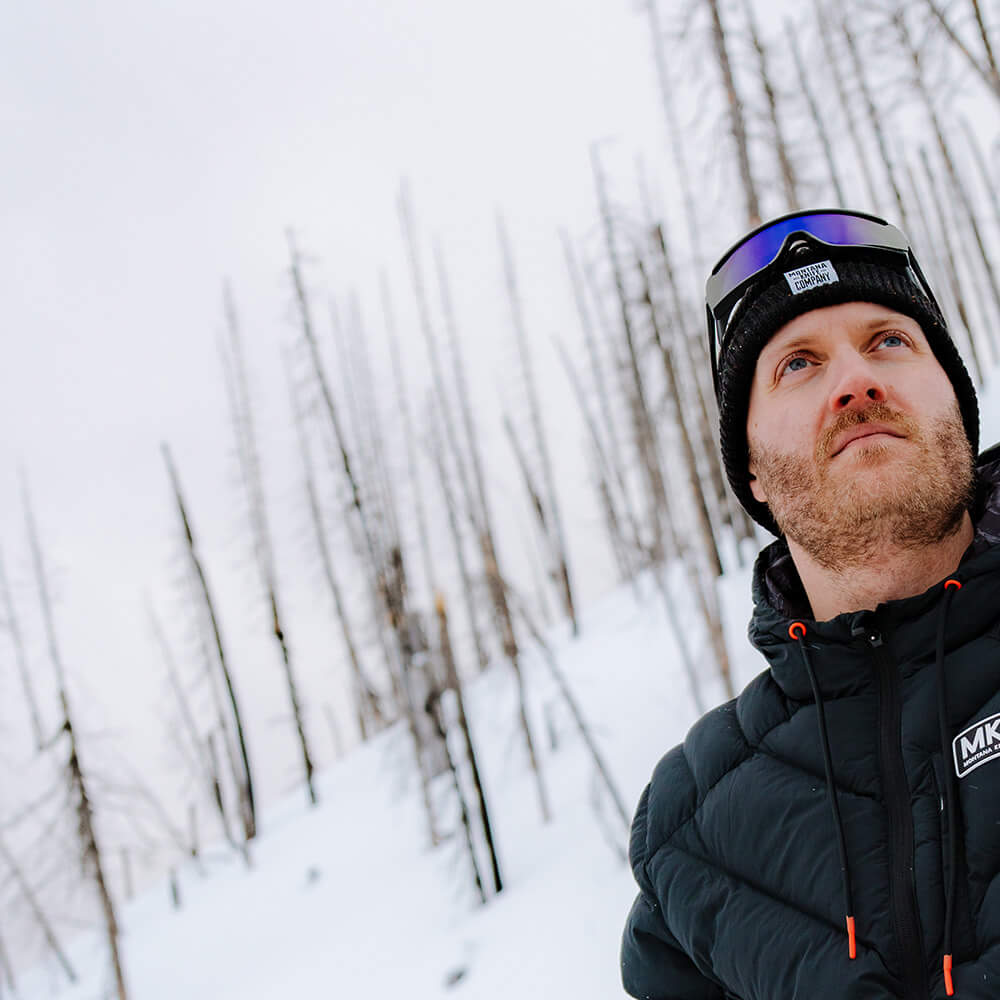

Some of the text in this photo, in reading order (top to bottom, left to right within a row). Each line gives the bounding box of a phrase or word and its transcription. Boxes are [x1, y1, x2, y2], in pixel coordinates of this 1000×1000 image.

[788, 262, 828, 278] MONTANA
[794, 271, 832, 291] COMPANY
[963, 747, 993, 768] MONTANA
